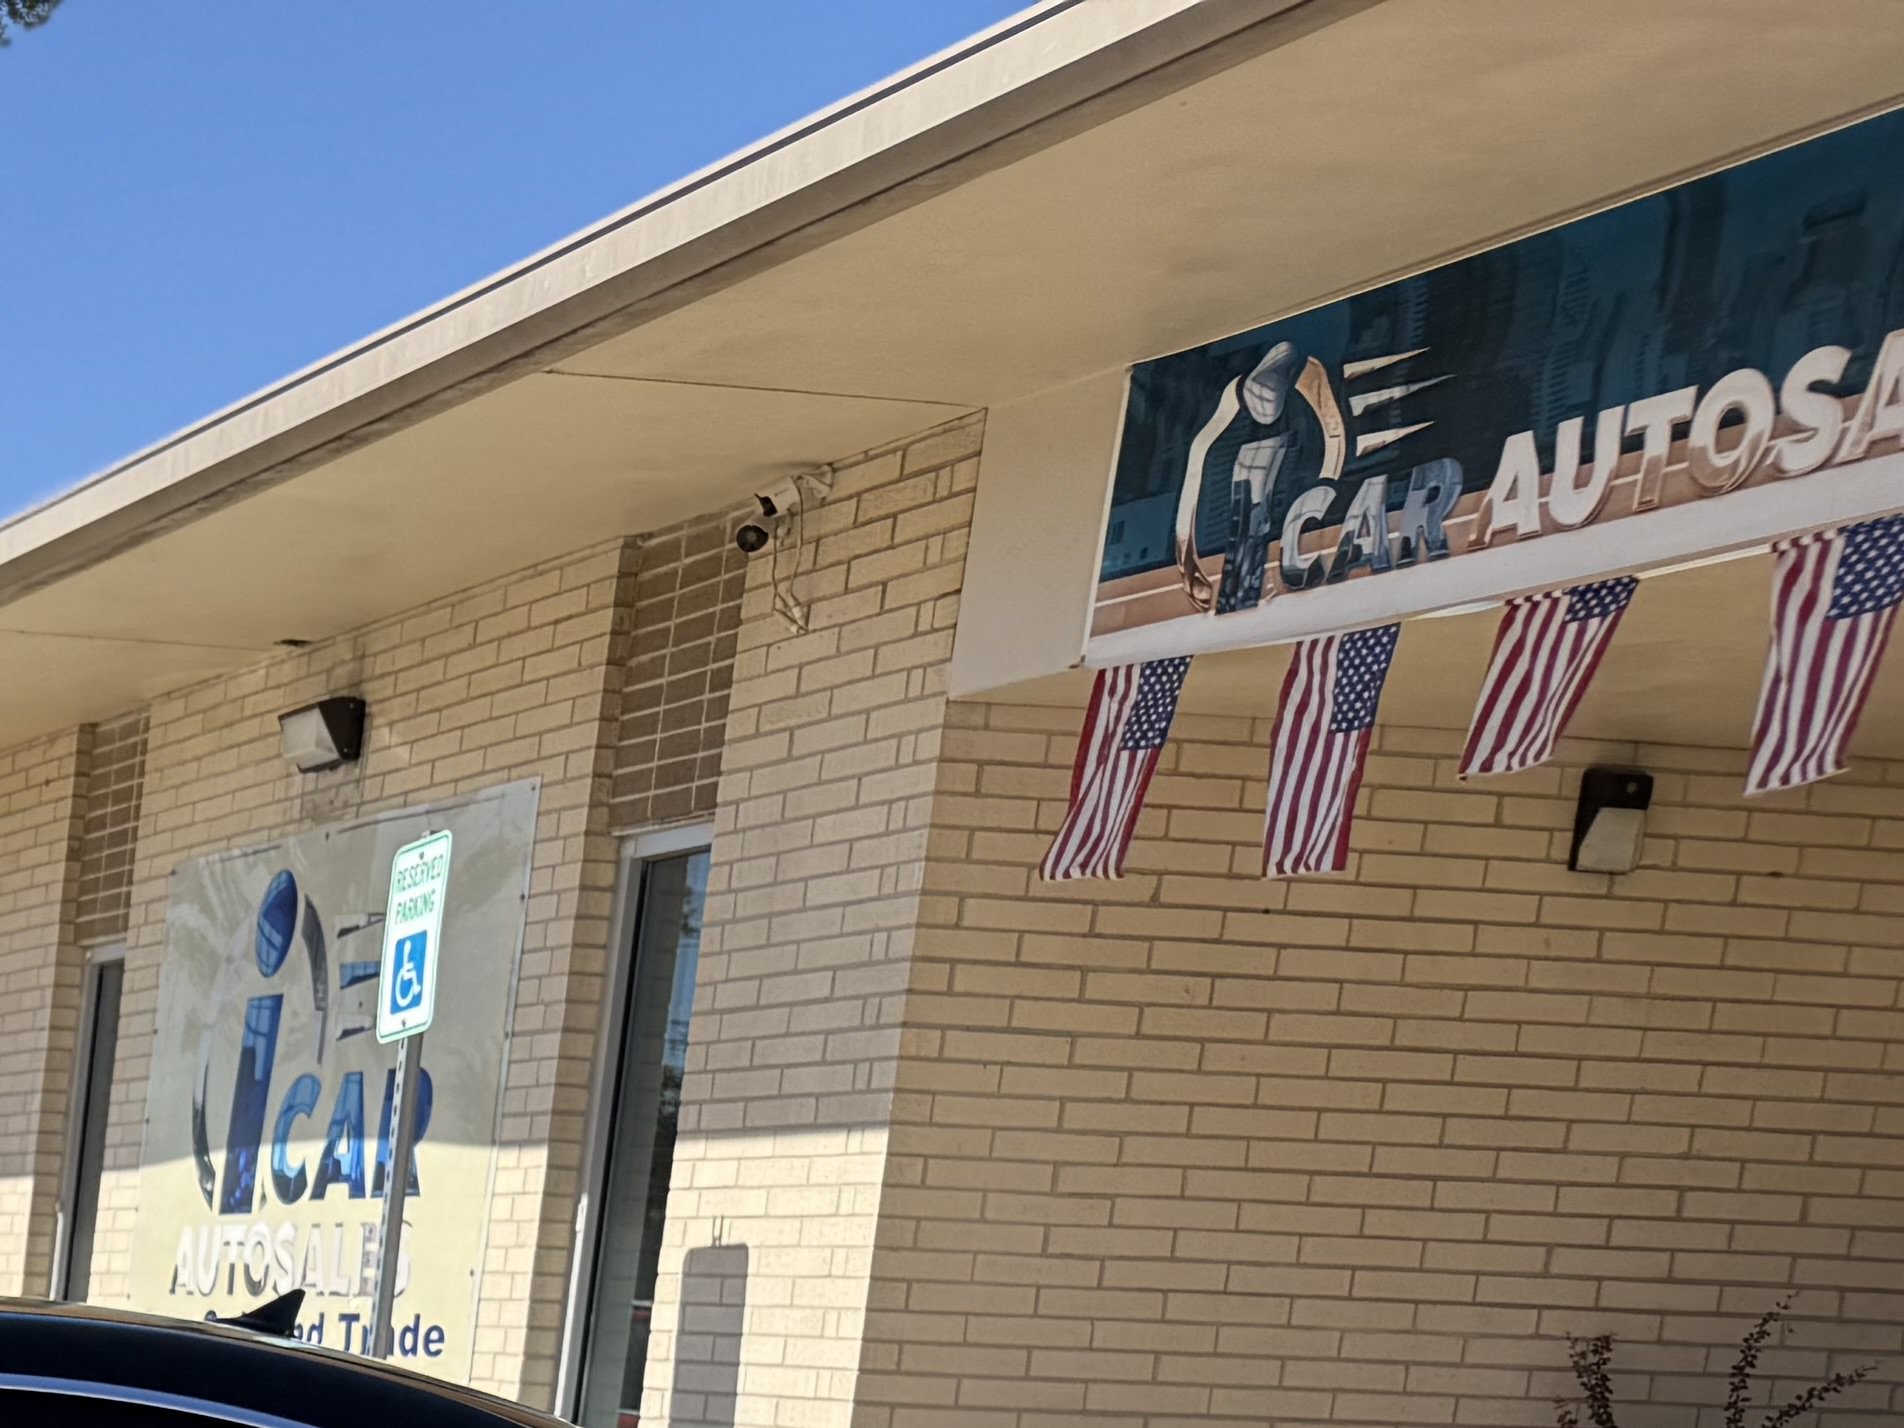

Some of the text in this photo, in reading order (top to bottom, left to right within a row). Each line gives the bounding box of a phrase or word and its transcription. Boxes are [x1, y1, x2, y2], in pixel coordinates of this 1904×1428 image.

[395, 854, 444, 893] RESERVED
[395, 888, 436, 925] PARKING
[337, 1313, 445, 1357] Trde
